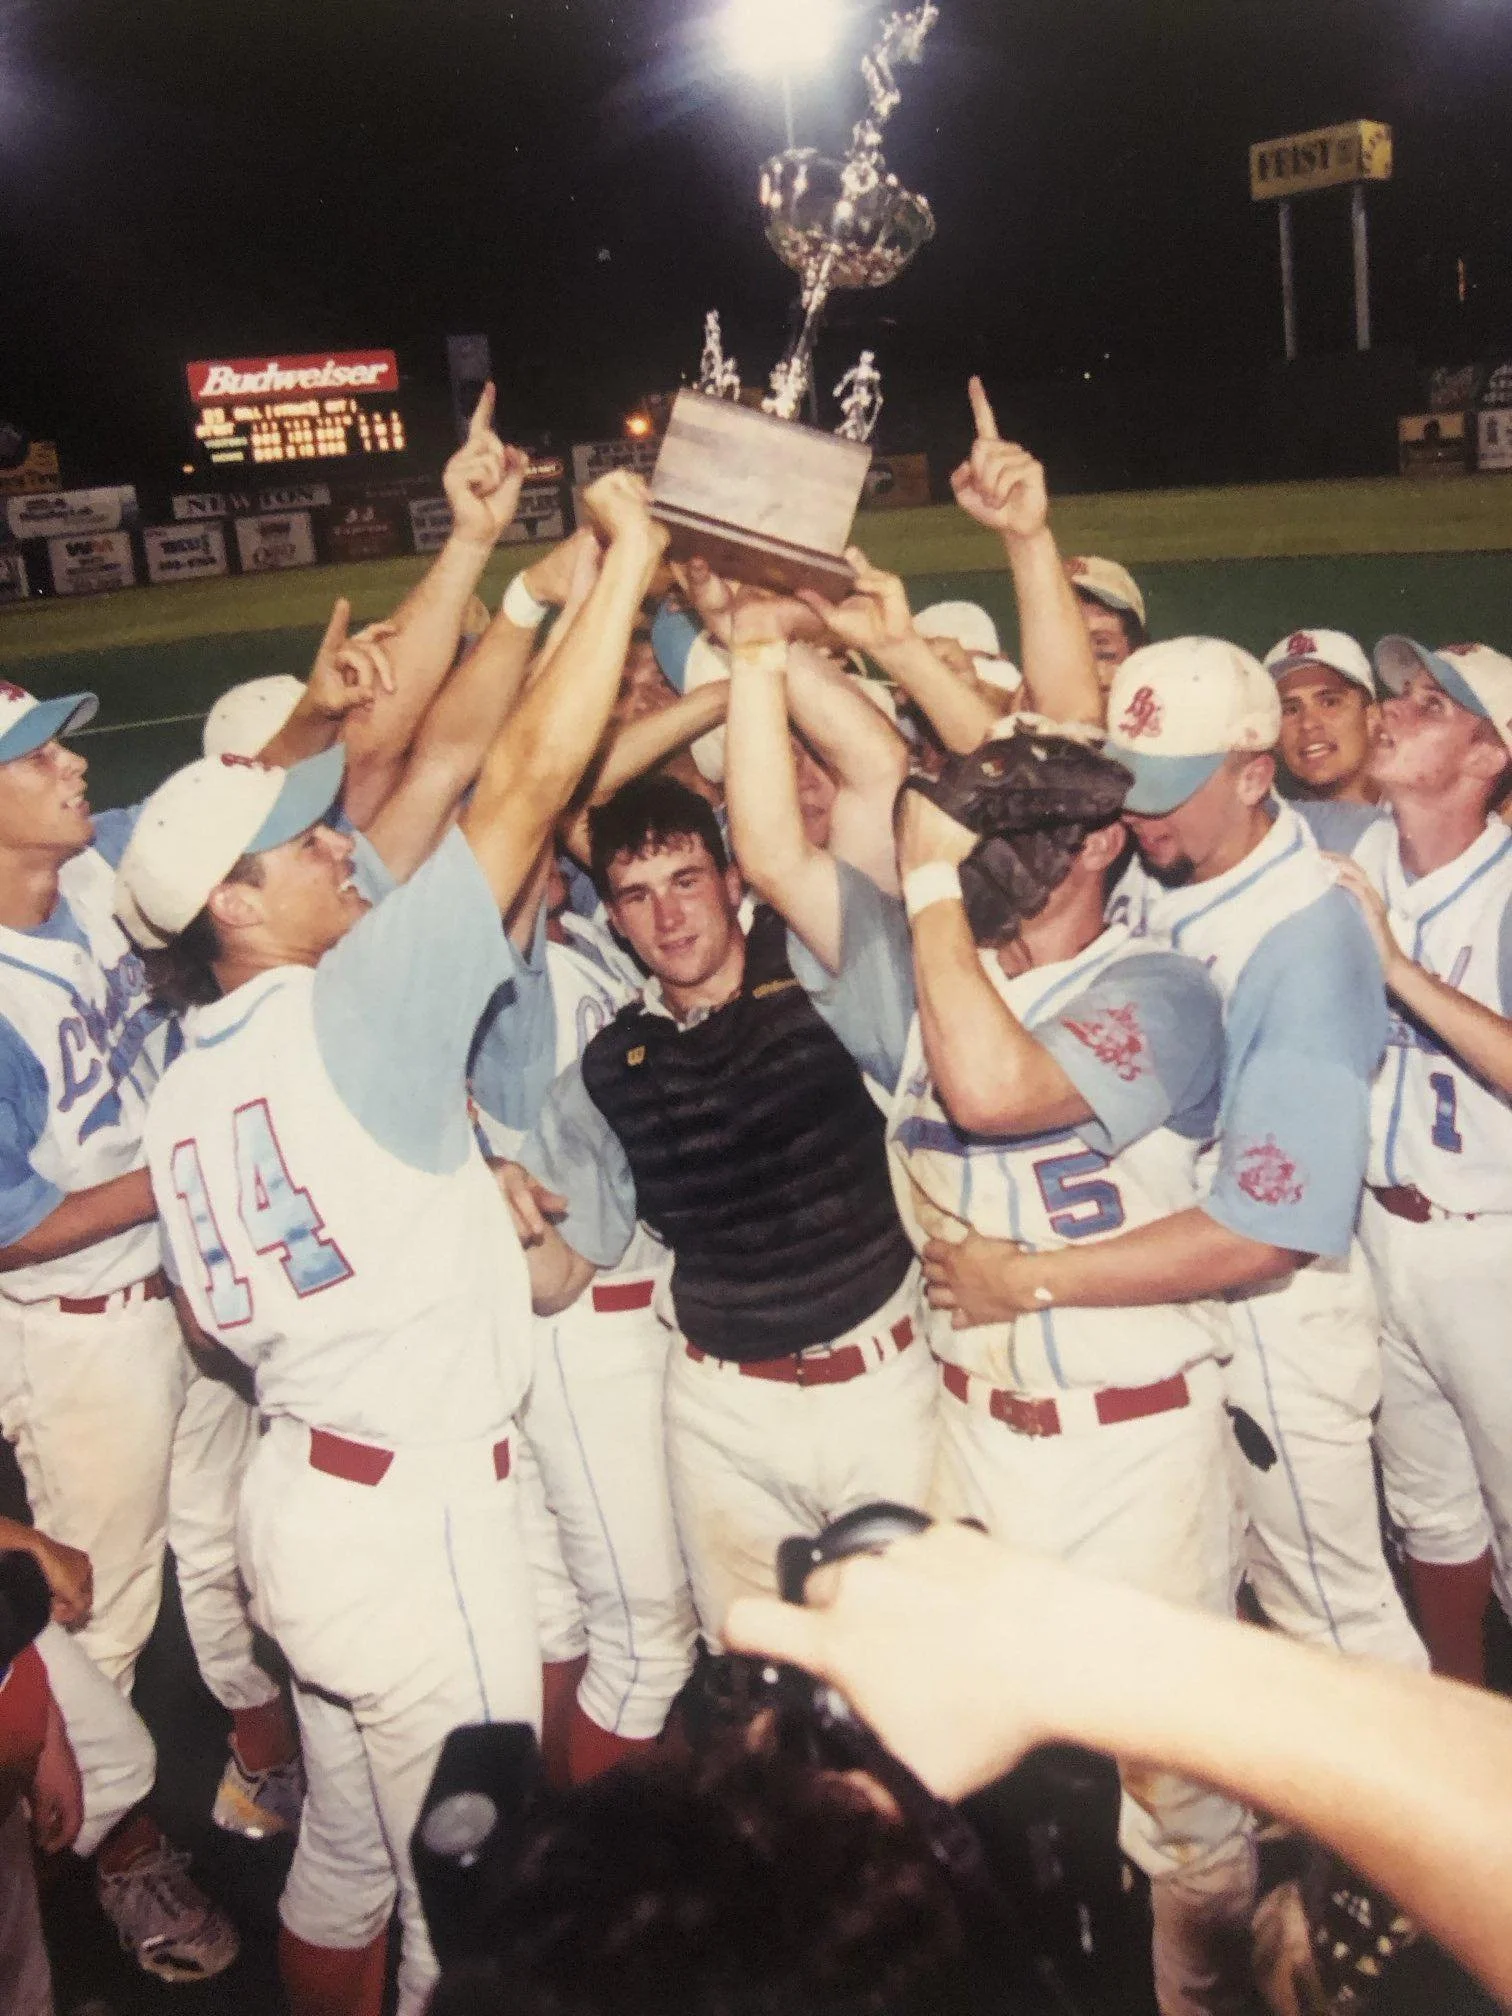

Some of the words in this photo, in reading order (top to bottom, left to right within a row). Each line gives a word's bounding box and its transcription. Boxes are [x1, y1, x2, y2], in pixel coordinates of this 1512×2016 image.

[198, 359, 389, 397] Budweiser
[1429, 1071, 1463, 1155] 1
[170, 1097, 356, 1331] 14
[1033, 1149, 1125, 1240] 5
